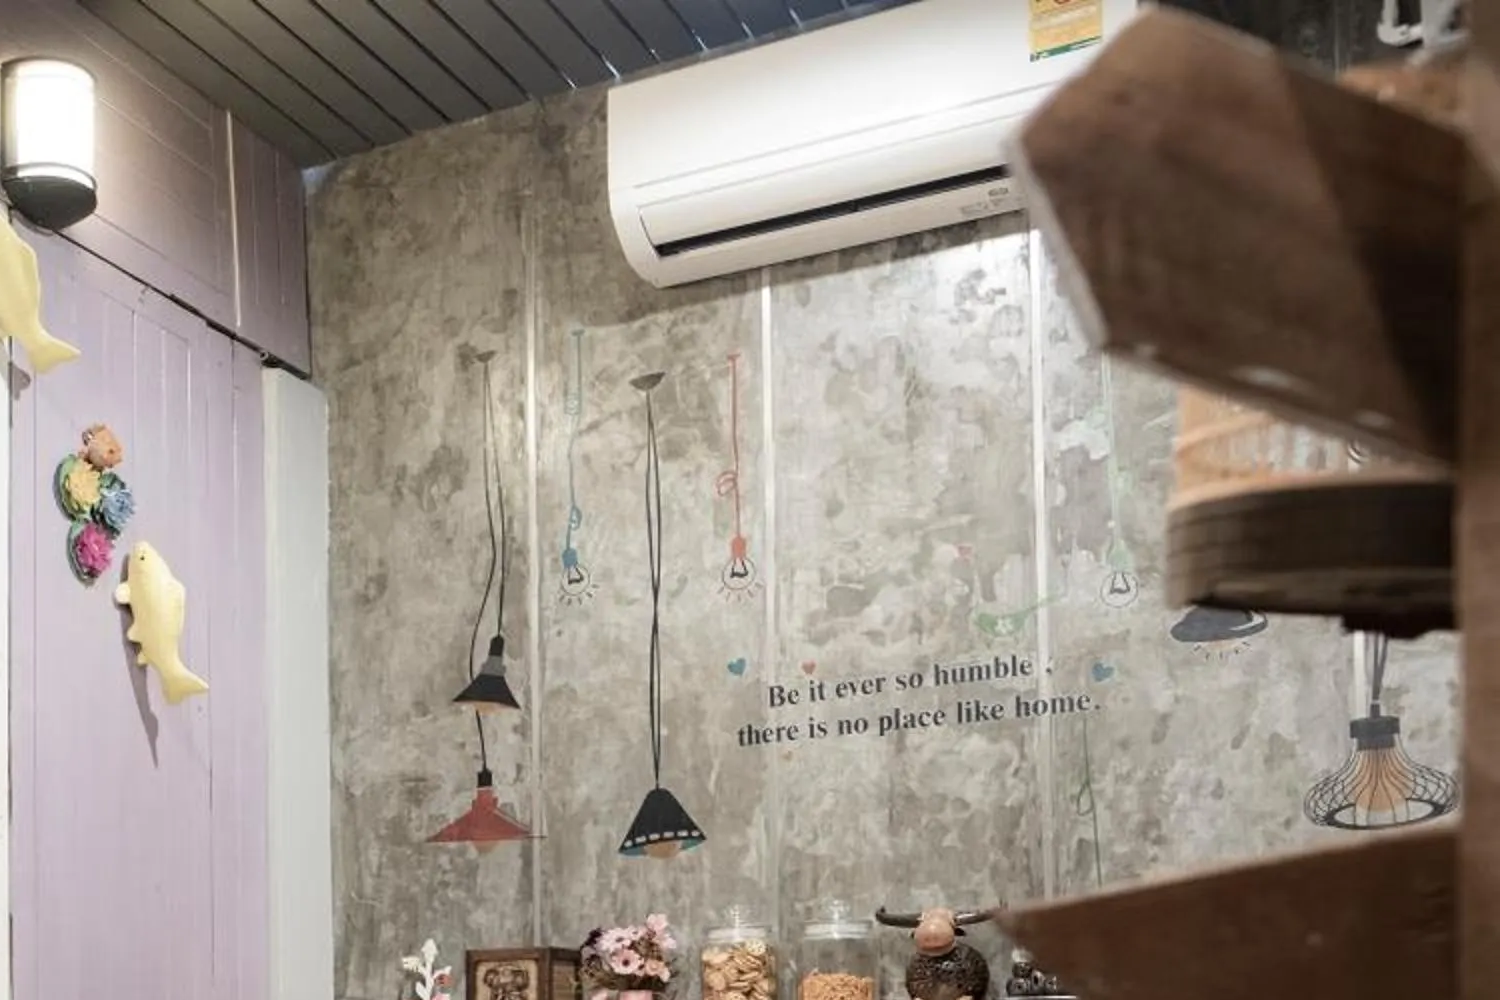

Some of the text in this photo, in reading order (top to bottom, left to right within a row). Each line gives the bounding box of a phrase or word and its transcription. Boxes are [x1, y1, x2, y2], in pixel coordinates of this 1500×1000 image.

[768, 685, 800, 708] Be
[808, 679, 826, 703] it
[835, 675, 887, 699] ever
[894, 671, 924, 692] so
[737, 692, 1101, 748] there is no place like home.
